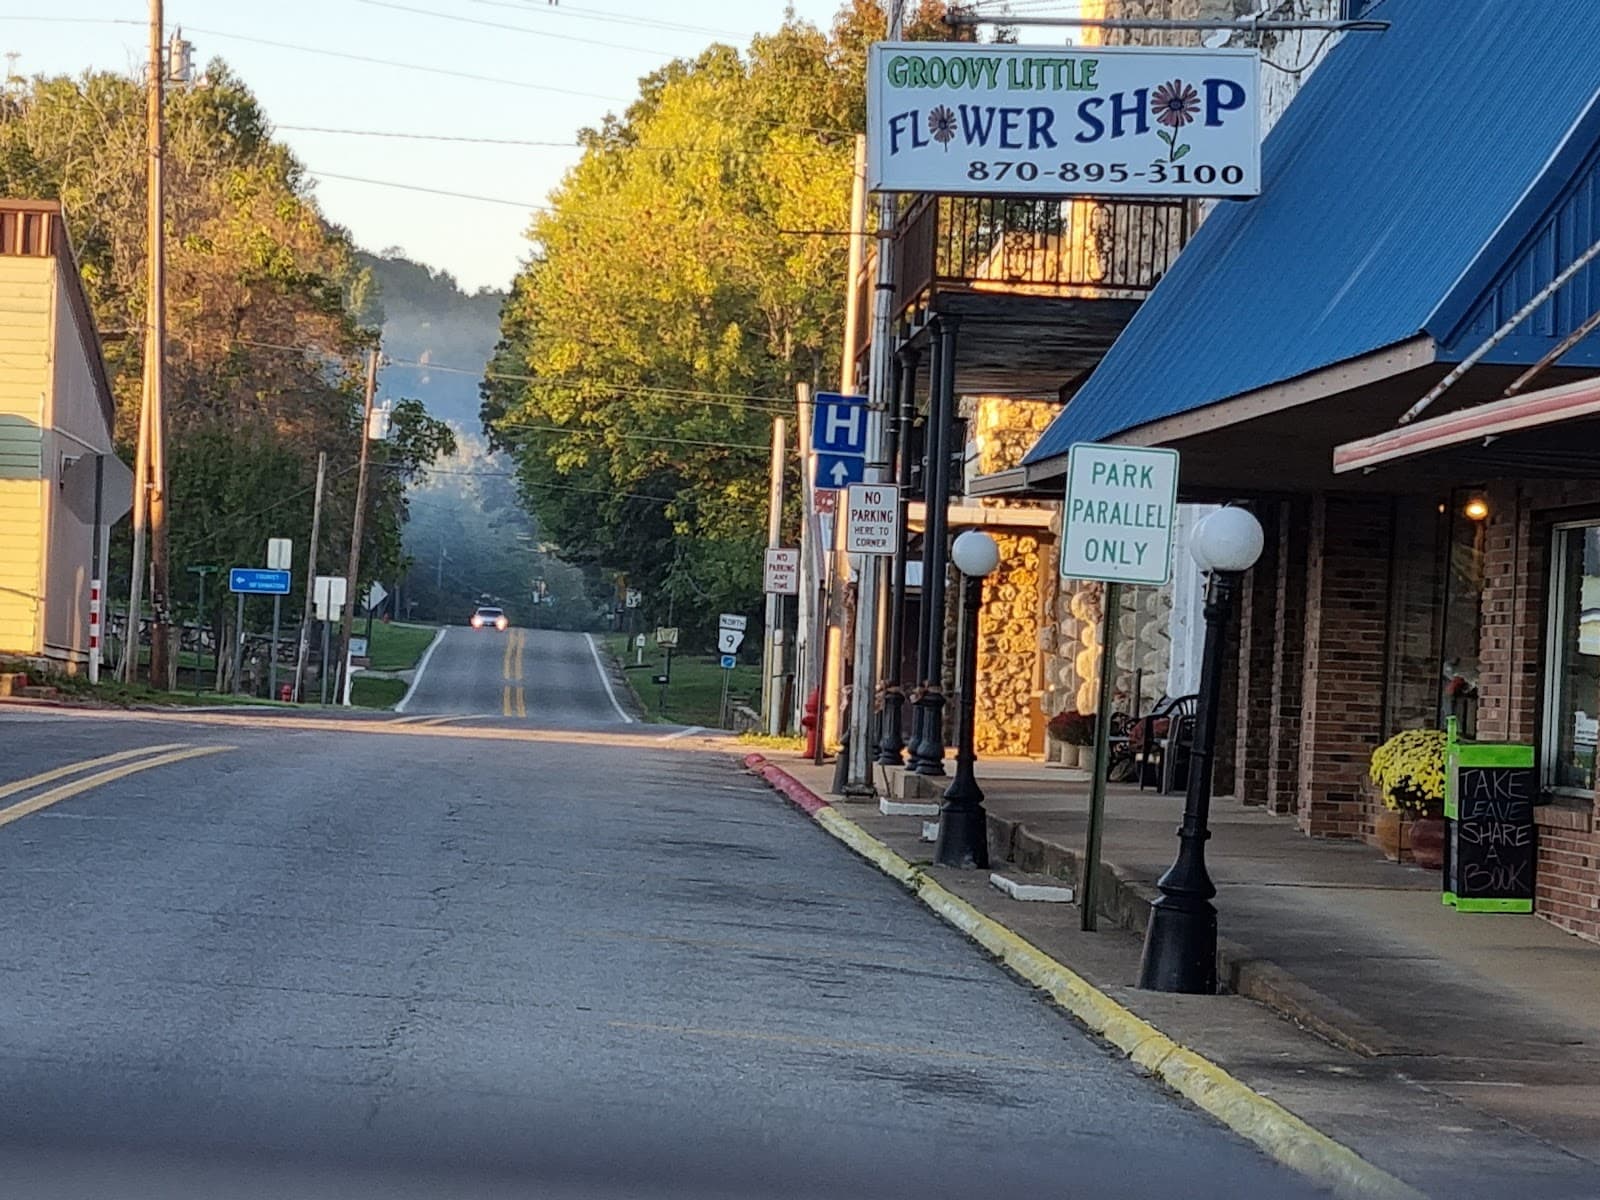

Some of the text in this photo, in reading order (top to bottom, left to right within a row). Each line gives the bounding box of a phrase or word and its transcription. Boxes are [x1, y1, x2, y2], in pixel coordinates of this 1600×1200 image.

[887, 55, 1099, 92] GROOVY LITTLE
[966, 160, 1245, 185] 870-895-3100
[825, 404, 860, 446] H
[1091, 461, 1154, 489] PARK
[865, 491, 881, 504] NO
[851, 508, 893, 523] PARKING
[1071, 498, 1167, 529] PARALLEL
[854, 526, 889, 537] HERE TO
[855, 537, 887, 548] CORNER
[1084, 537, 1148, 566] ONLY
[768, 563, 795, 573] PARKING
[776, 553, 788, 562] NO
[773, 581, 788, 590] TIME
[774, 573, 788, 581] ANY
[726, 634, 735, 648] 9
[1459, 769, 1532, 799] TAKE
[1461, 799, 1530, 822] LEAVE
[1459, 822, 1532, 847] SHARE
[1484, 845, 1501, 865] A
[1464, 860, 1530, 892] BOOK
